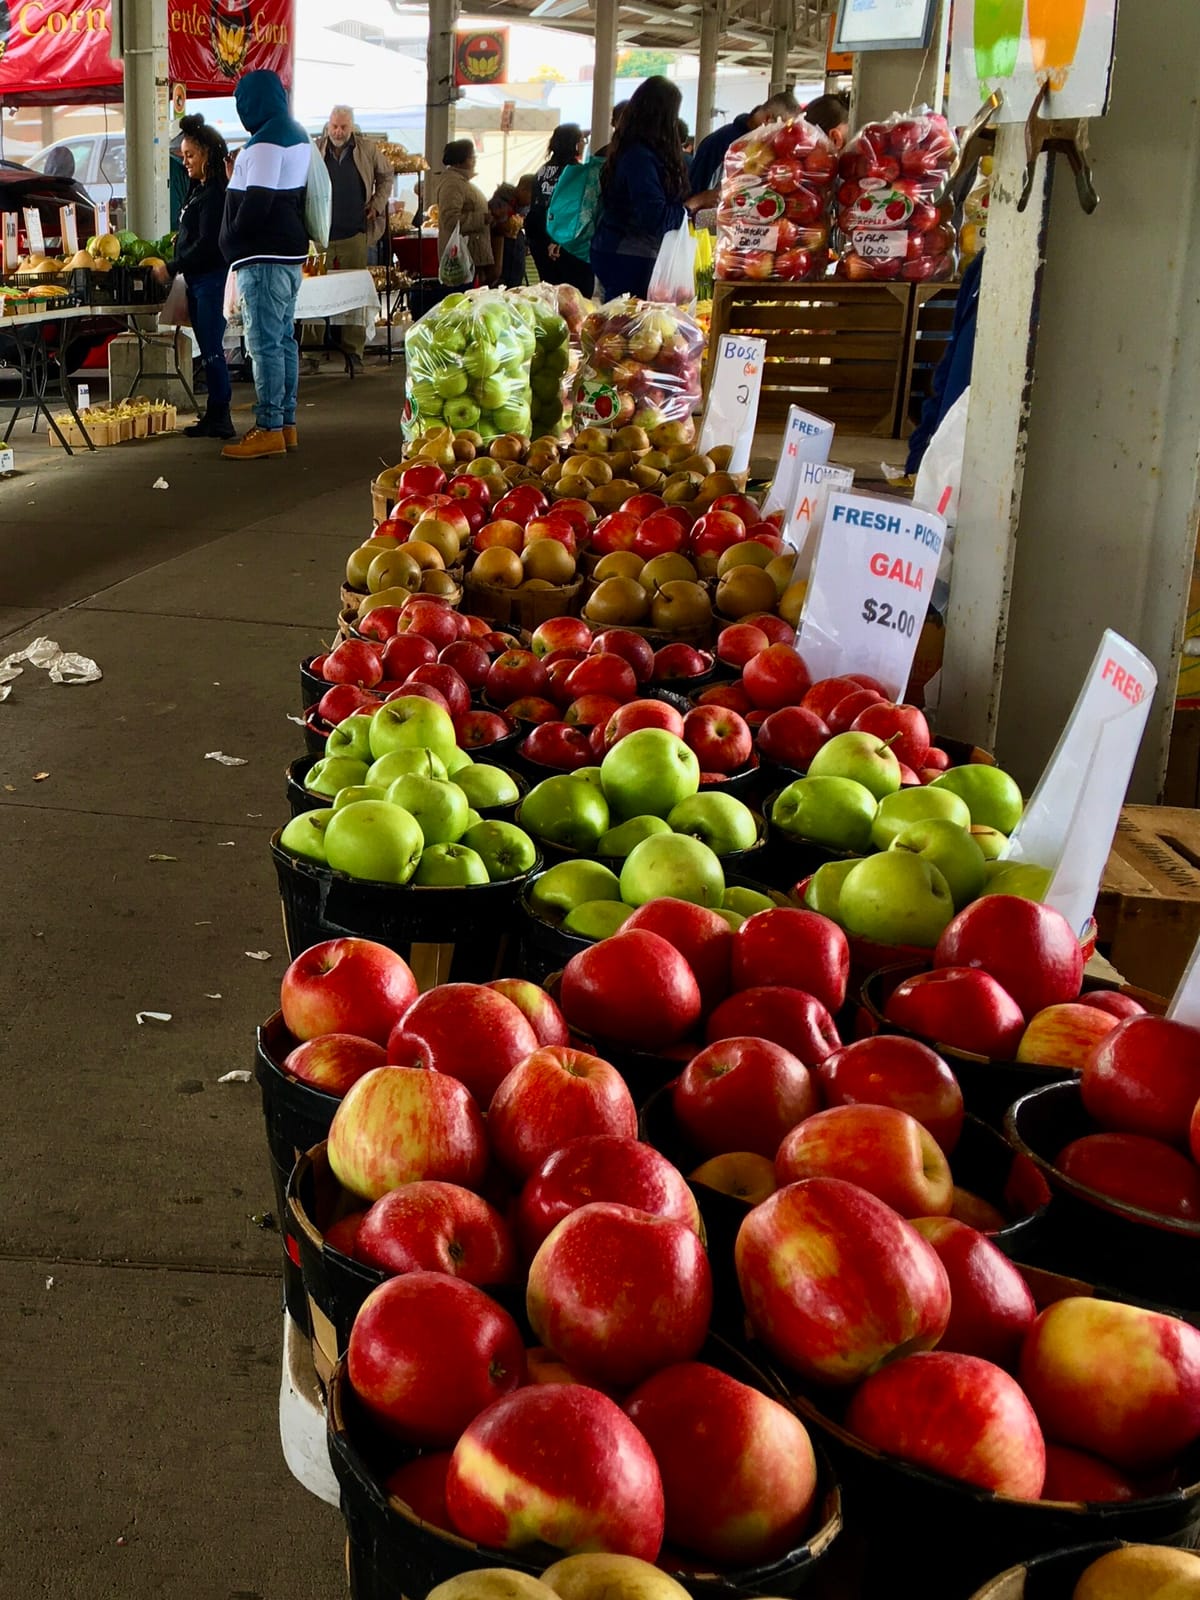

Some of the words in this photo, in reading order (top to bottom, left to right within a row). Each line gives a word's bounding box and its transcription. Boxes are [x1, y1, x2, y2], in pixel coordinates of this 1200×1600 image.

[19, 1, 108, 37] Corn
[168, 3, 207, 36] ettle
[254, 9, 288, 45] Corn
[854, 231, 889, 242] GALA
[792, 418, 824, 436] FRES
[832, 505, 902, 535] FRESH
[869, 552, 924, 592] GALA
[861, 597, 915, 638] $2.00
[1102, 657, 1146, 706] FRES
